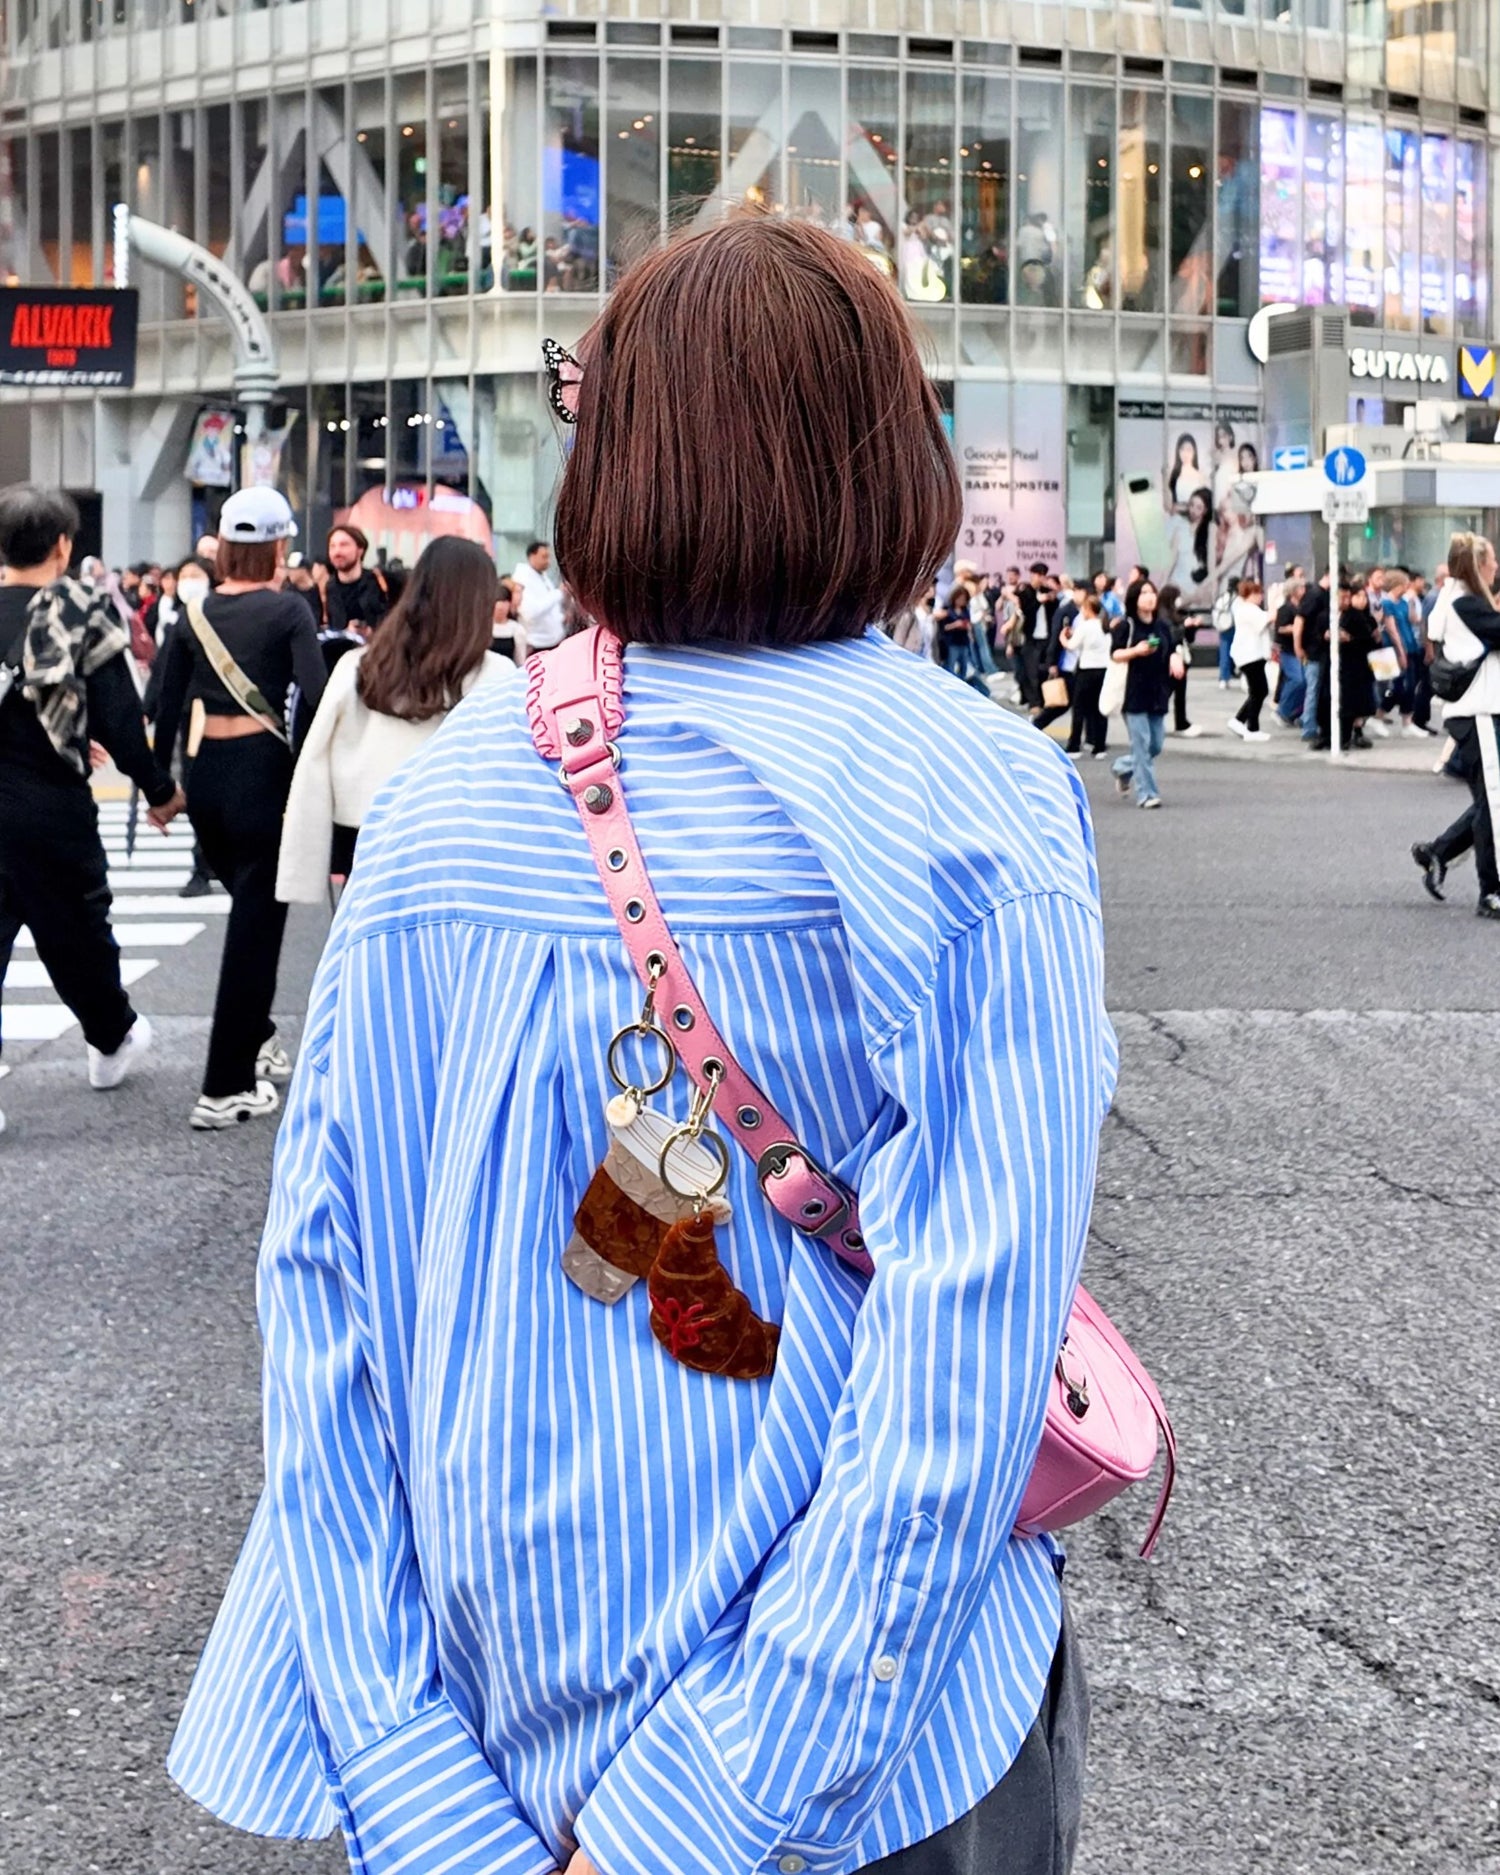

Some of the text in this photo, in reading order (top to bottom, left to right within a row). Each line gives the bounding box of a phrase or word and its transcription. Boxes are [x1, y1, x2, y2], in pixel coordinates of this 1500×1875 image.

[10, 303, 114, 347] ALVARK
[1348, 347, 1449, 383] SUTAYA
[964, 447, 1039, 462] Google Pixel
[1016, 538, 1058, 548] SHIBUYA
[1016, 551, 1058, 560] TSUTAYA
